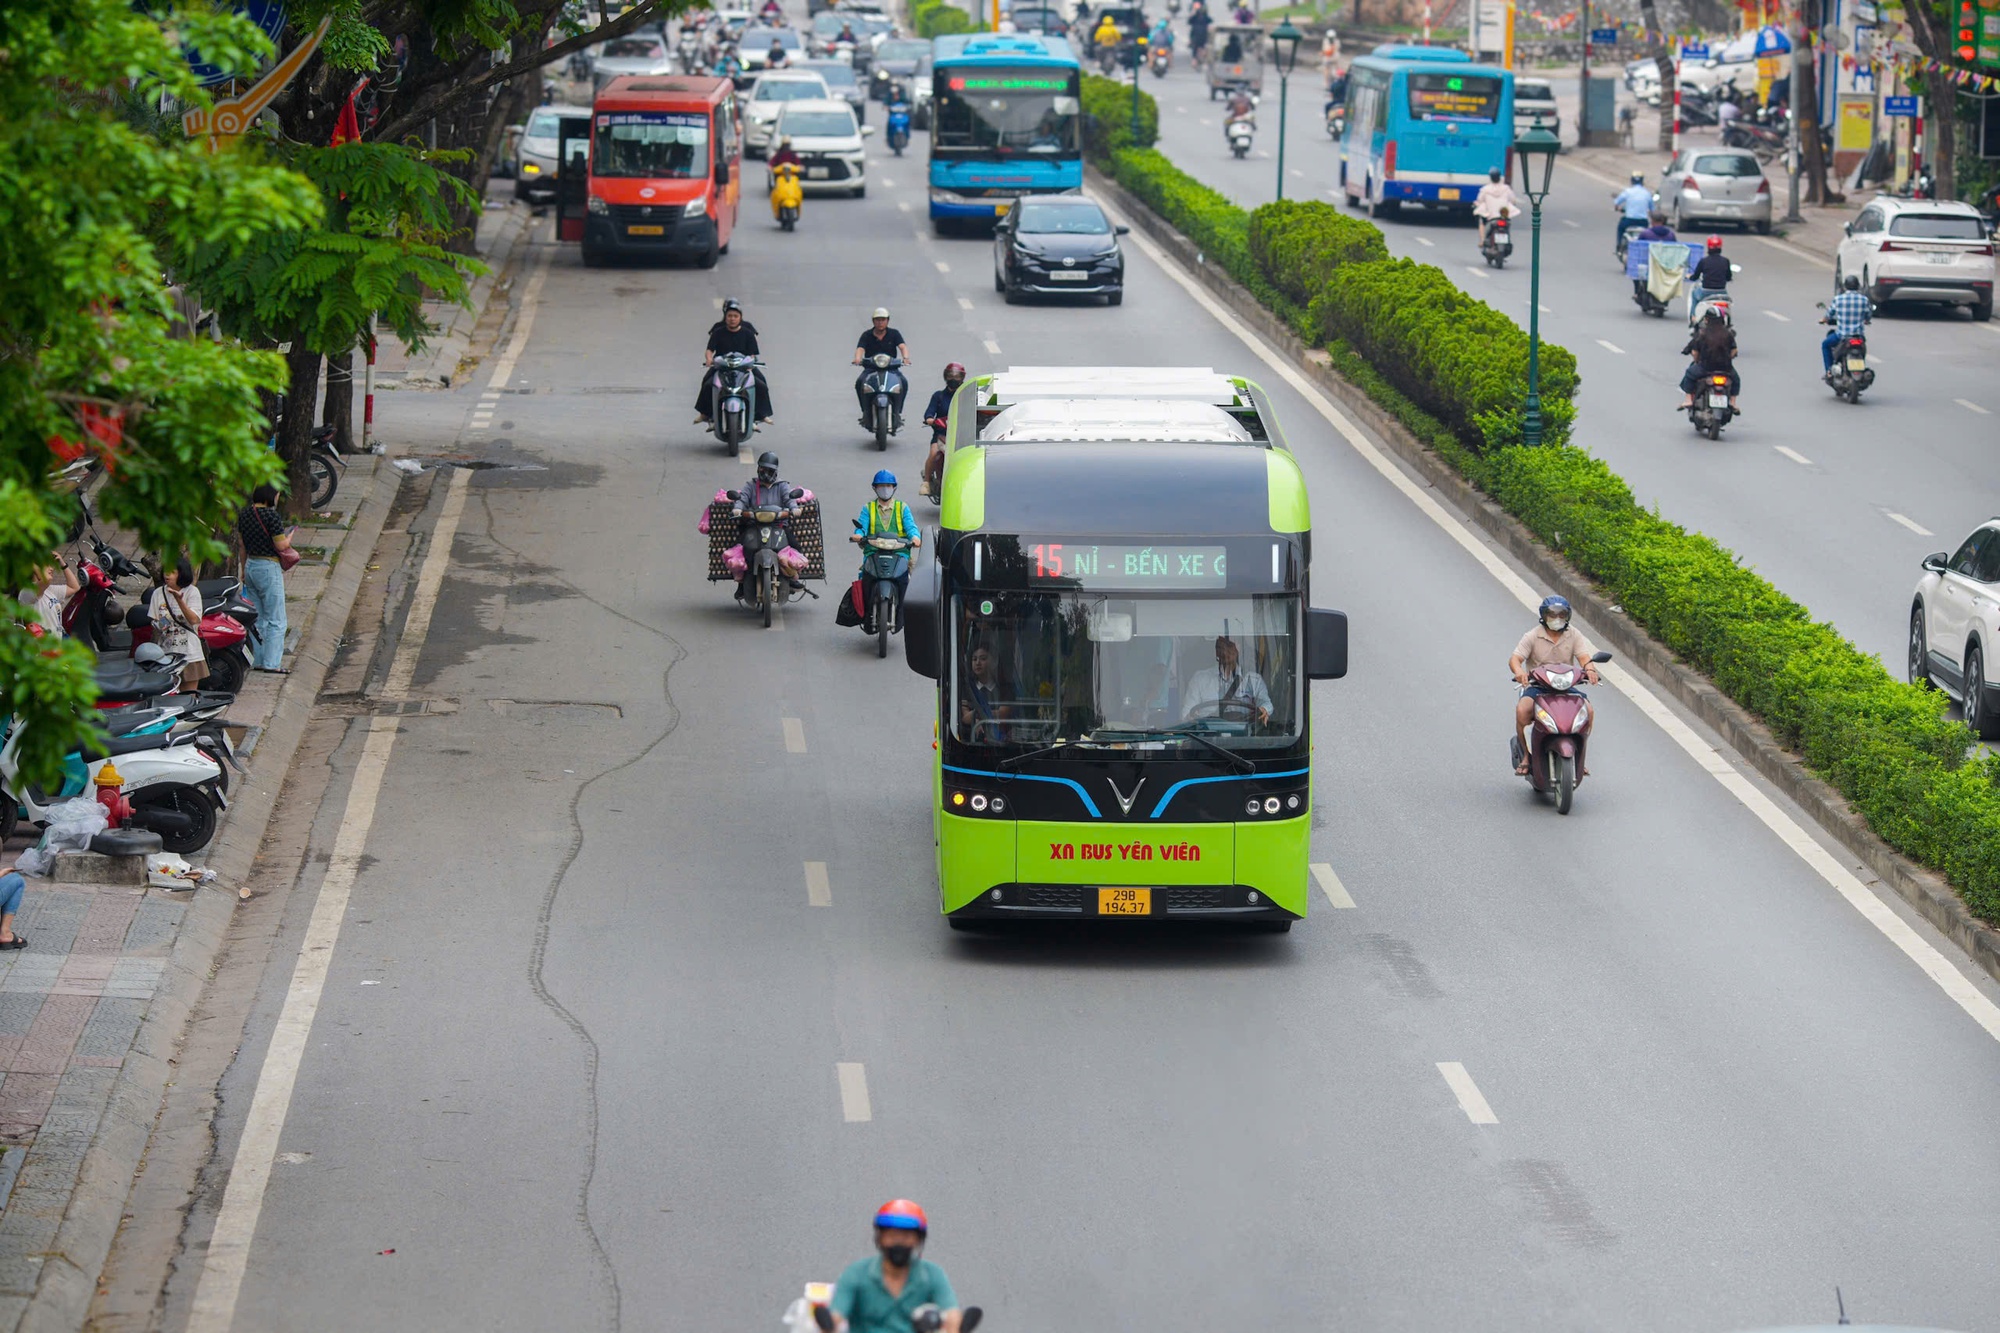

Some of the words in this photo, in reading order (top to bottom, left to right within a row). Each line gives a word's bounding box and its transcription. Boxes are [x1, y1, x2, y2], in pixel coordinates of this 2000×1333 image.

[1034, 544, 1063, 578] 15
[1075, 546, 1099, 575] NỈ
[1125, 547, 1168, 576] BẾN
[1178, 554, 1204, 575] XE
[1050, 844, 1075, 860] XN
[1081, 844, 1113, 861] BUS
[1118, 841, 1153, 861] YÊN
[1160, 842, 1200, 862] VIÊN
[1113, 890, 1136, 901] 29B
[1105, 903, 1145, 914] 194.37
